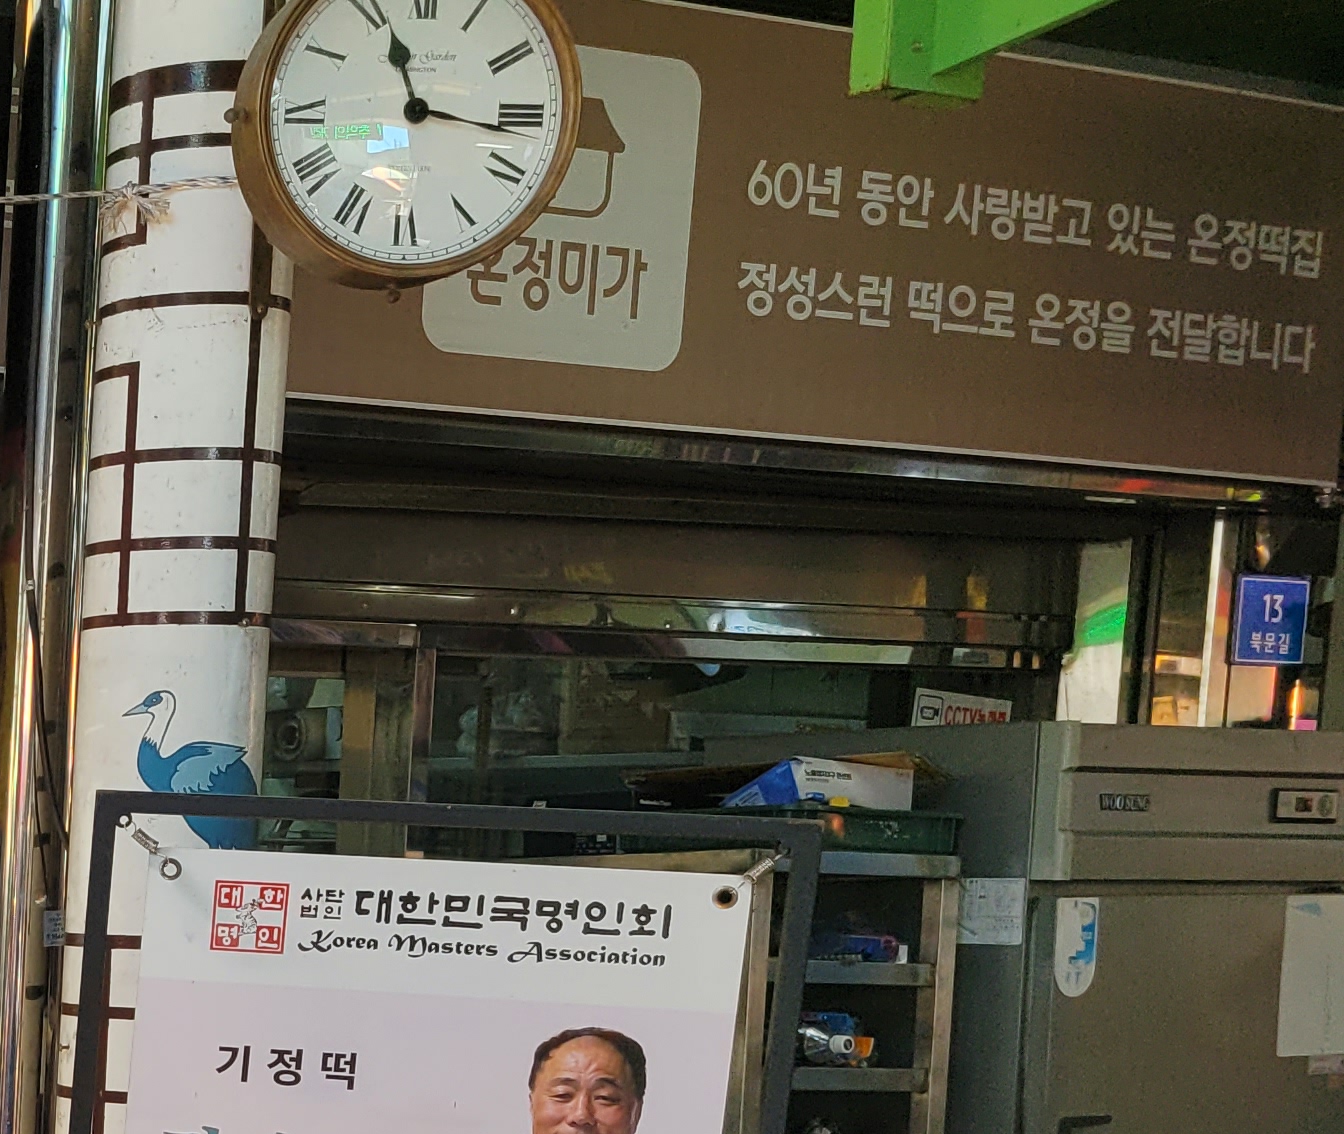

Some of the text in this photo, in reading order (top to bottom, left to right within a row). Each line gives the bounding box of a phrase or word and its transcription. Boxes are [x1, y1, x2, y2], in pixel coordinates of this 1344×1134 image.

[746, 159, 1324, 280] 60년 동안 사랑받고 있는 온정떡집
[467, 236, 648, 320] 온정미가
[737, 260, 1316, 375] 정성스런 떡으로 온정을 전달합니다
[1263, 593, 1285, 624] 13
[1249, 631, 1291, 655] 북문길
[299, 903, 343, 921] 법인
[300, 886, 346, 903] 사단
[354, 888, 673, 940] 대한민국명인회
[297, 929, 666, 968] Korea Masters Association
